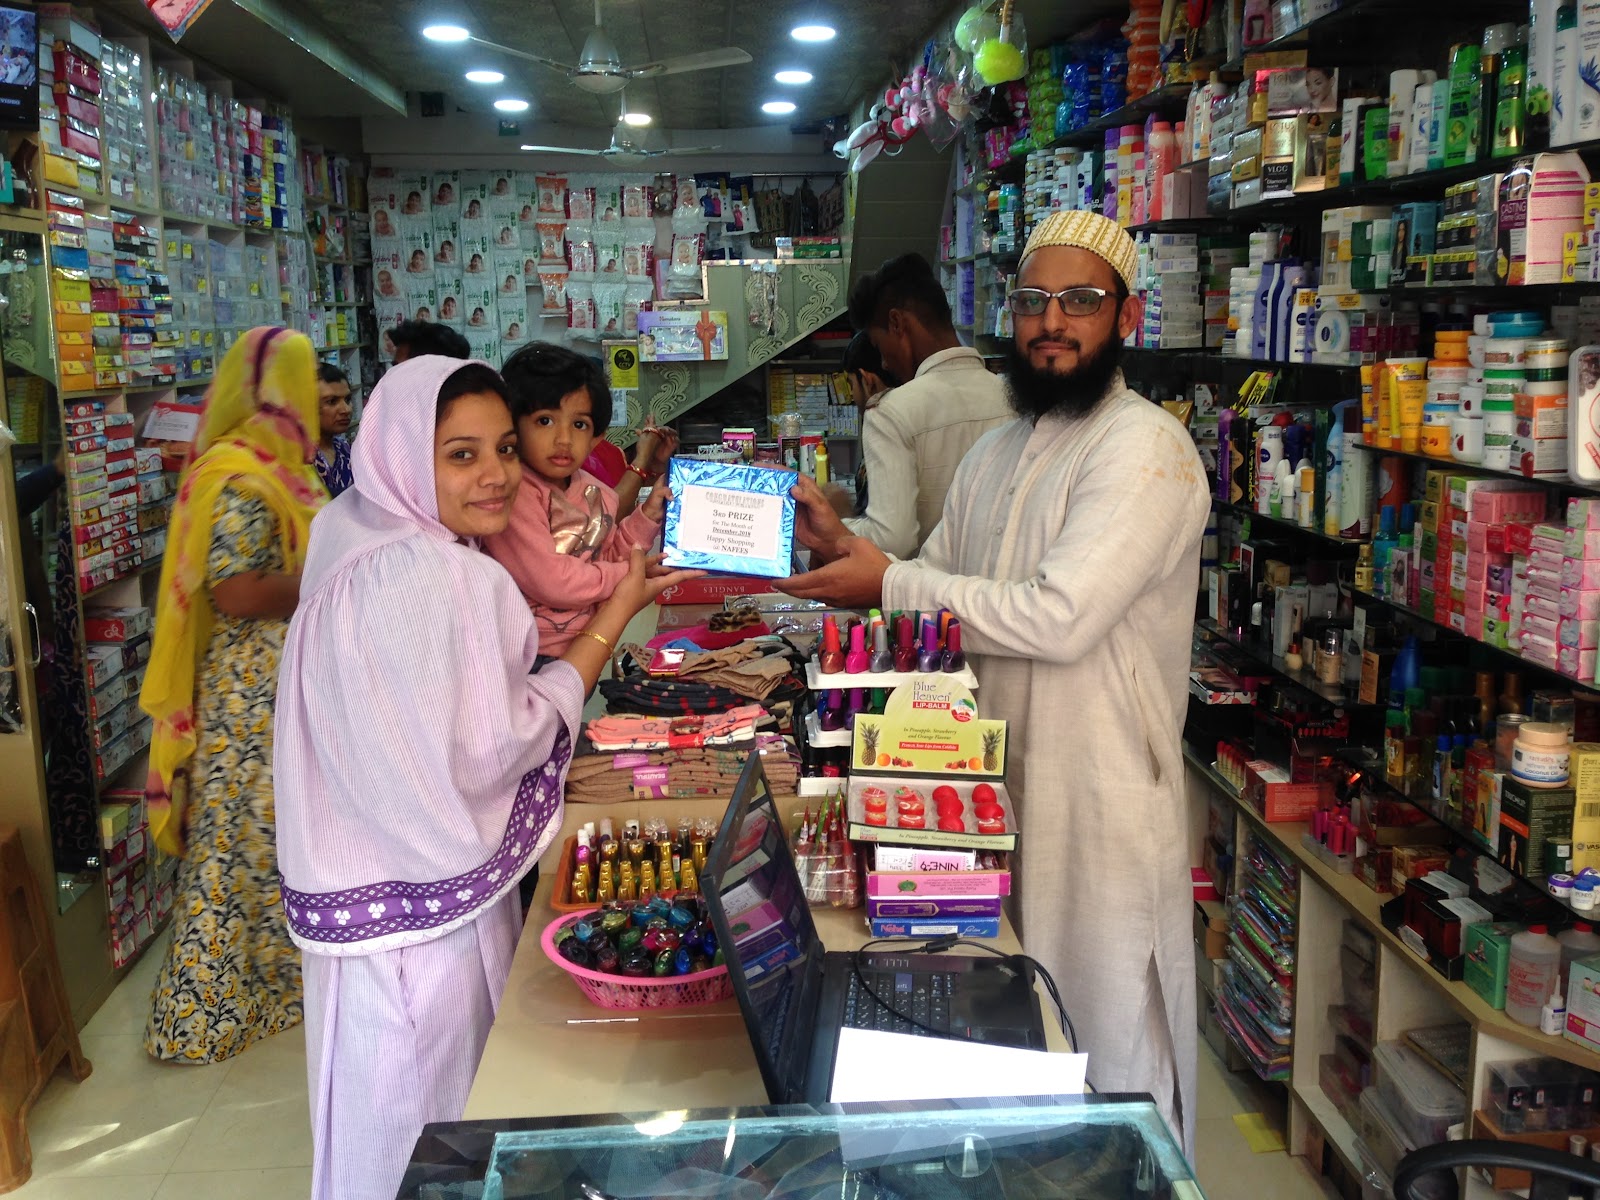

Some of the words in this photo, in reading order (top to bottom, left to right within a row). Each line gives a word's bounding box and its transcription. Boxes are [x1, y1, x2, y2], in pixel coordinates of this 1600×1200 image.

[1501, 201, 1526, 214] CASTING
[728, 512, 754, 521] PRIZE
[706, 534, 726, 544] Happy
[728, 538, 754, 548] Shopping
[703, 586, 744, 594] BANGLES
[914, 681, 936, 692] Blue
[913, 691, 950, 702] Heaven
[881, 924, 905, 933] Neha
